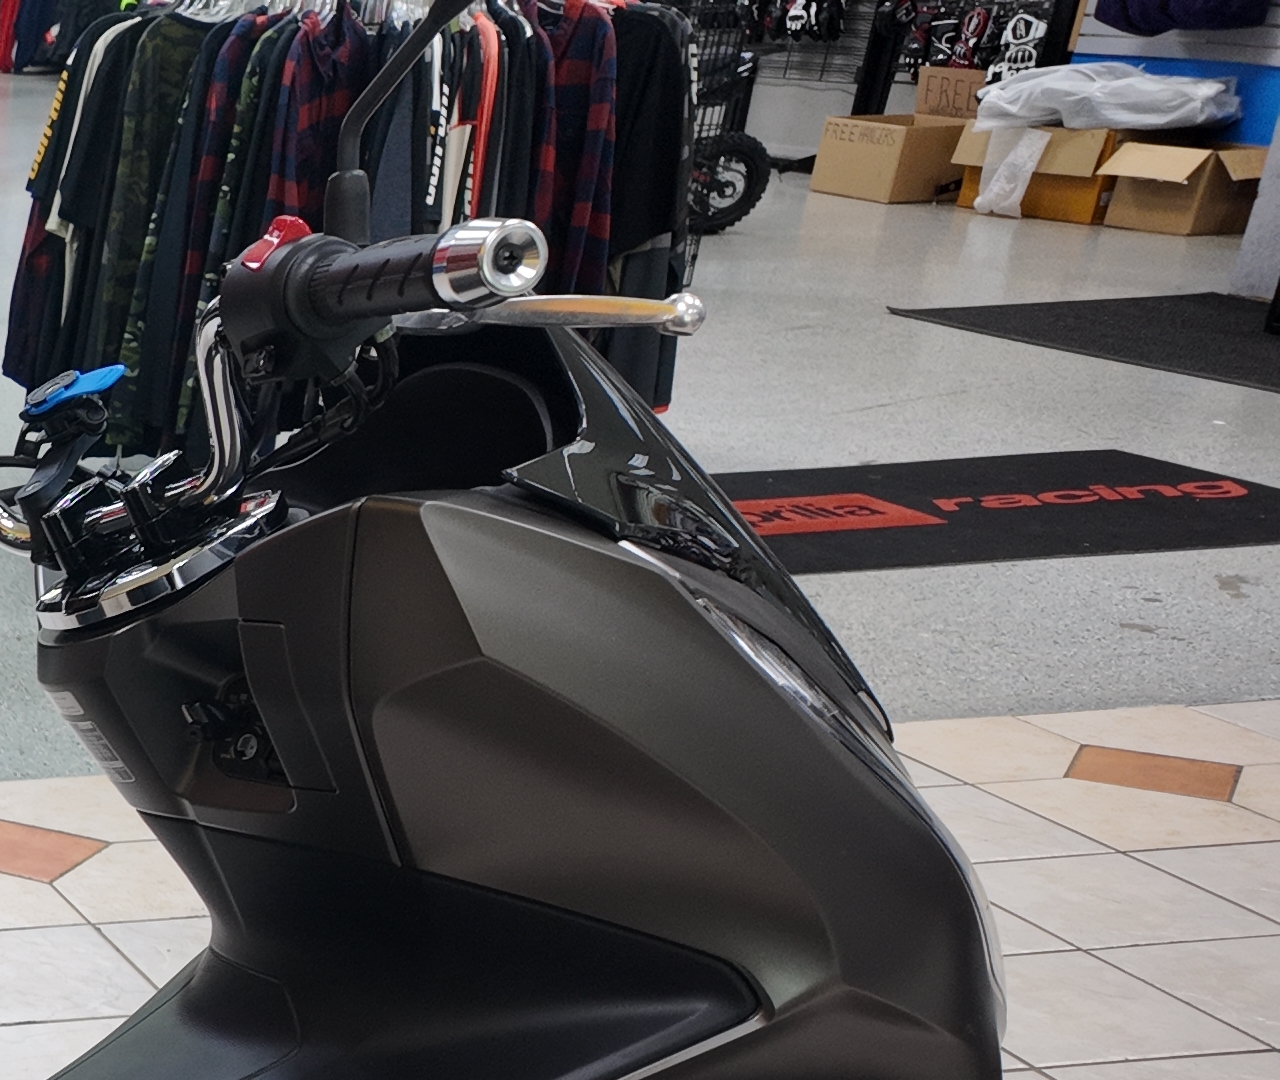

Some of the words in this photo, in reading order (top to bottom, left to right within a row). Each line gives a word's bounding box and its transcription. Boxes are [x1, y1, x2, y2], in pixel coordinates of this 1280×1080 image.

[924, 74, 983, 112] FREE
[824, 121, 860, 143] FREE
[739, 503, 887, 528] prilia
[931, 479, 1249, 512] racing
